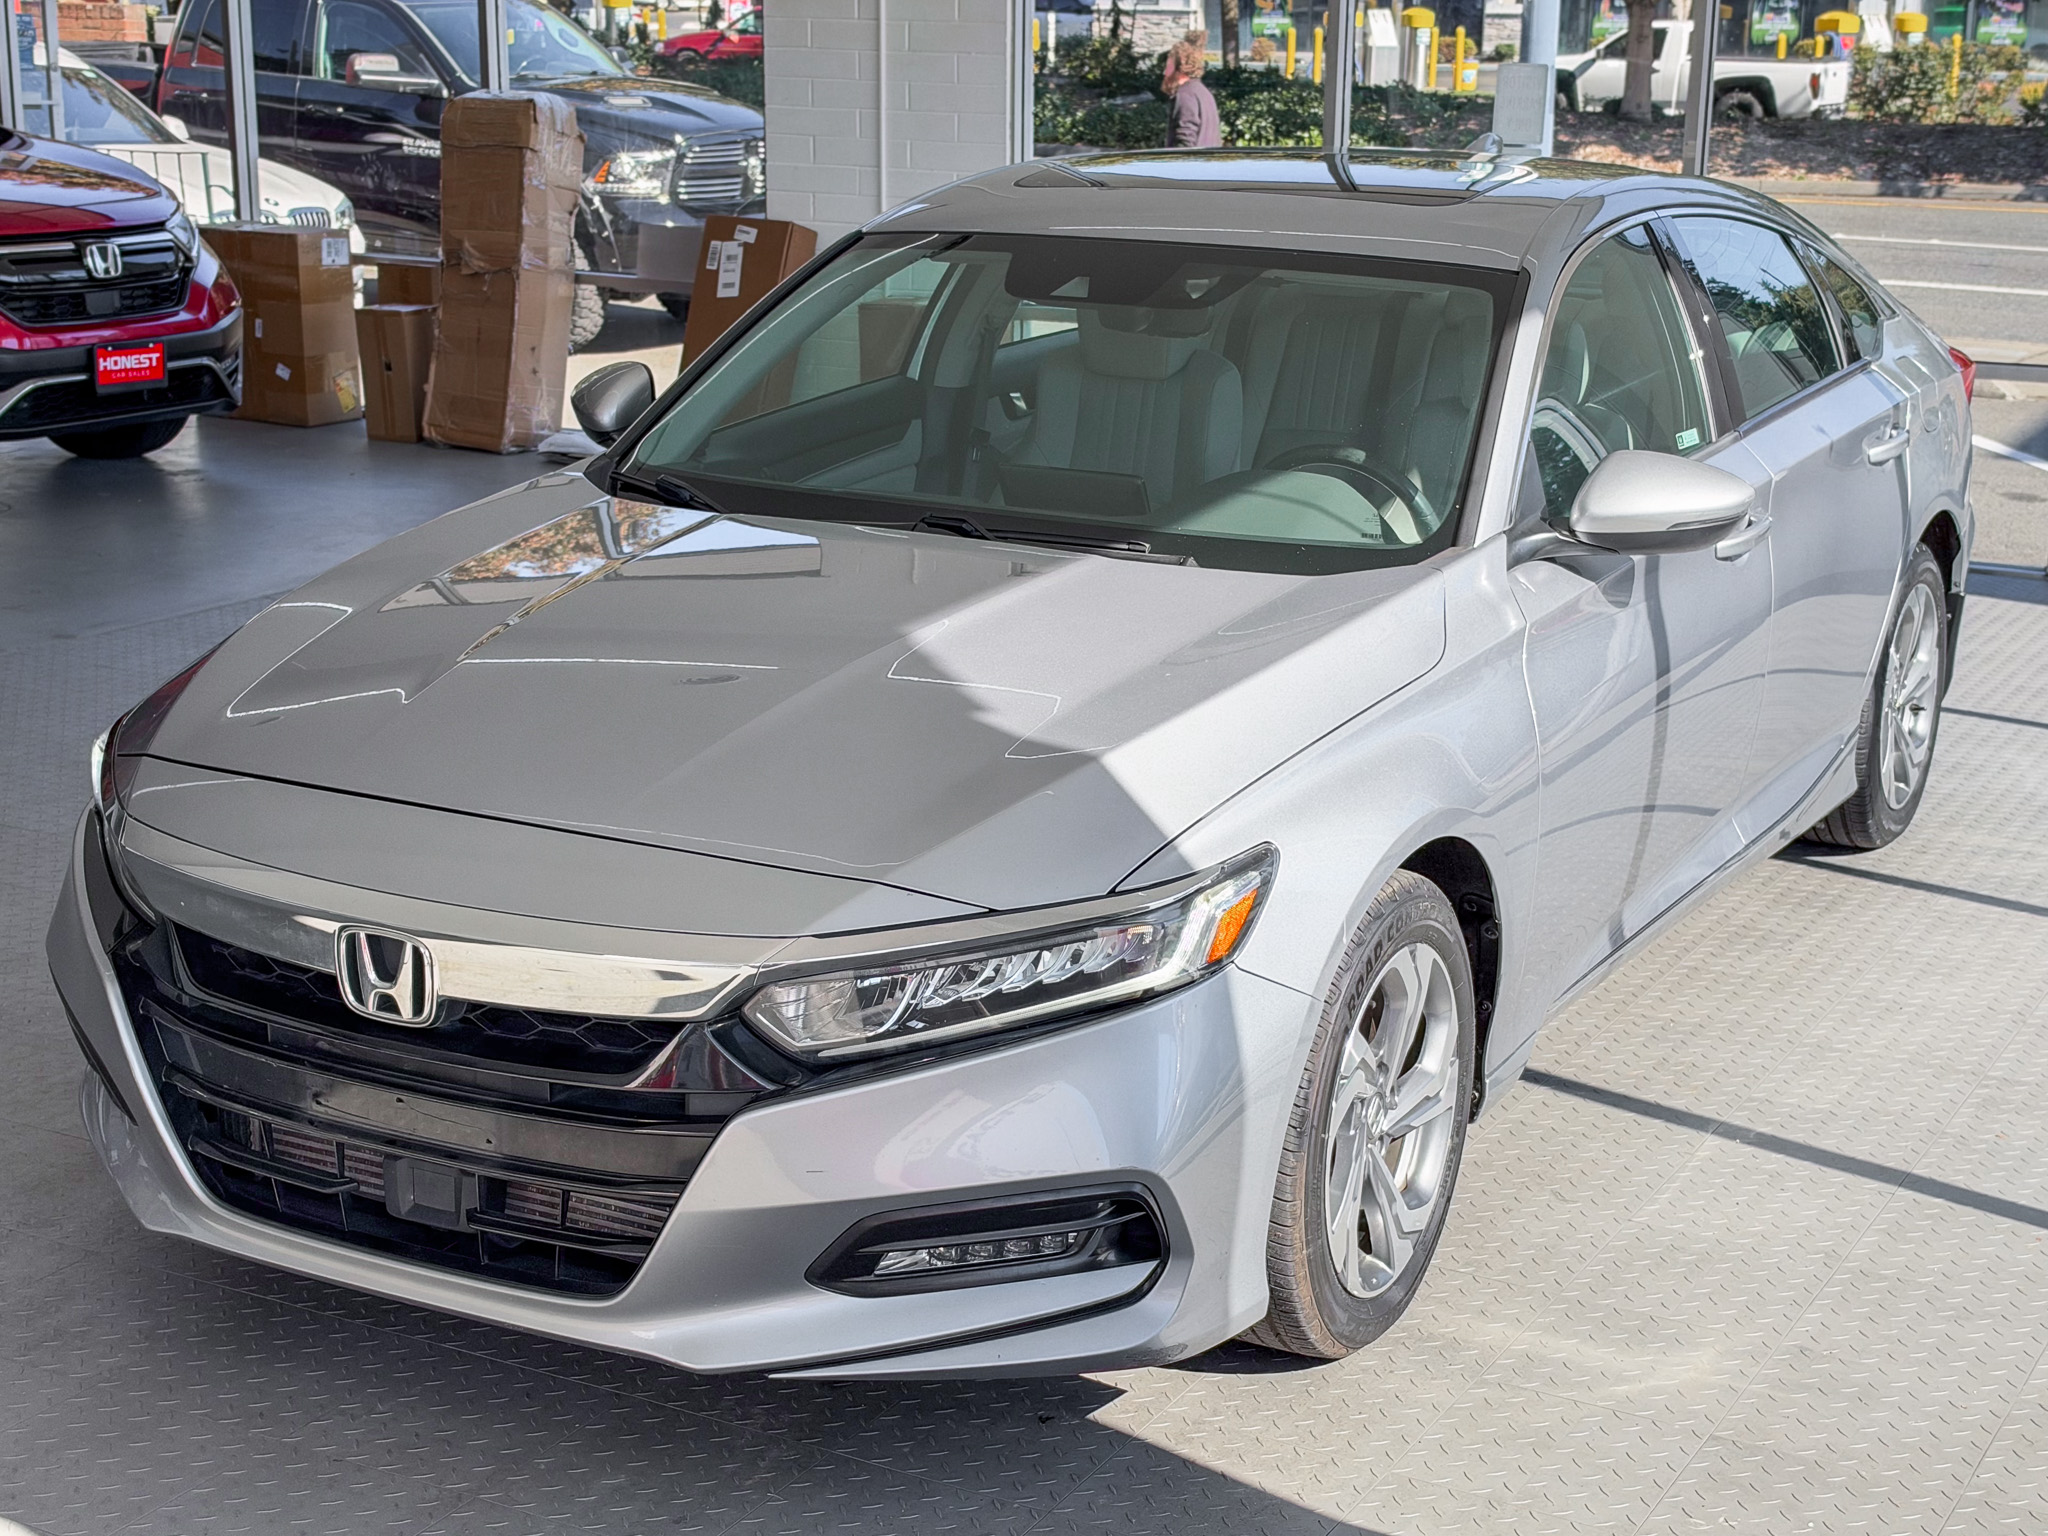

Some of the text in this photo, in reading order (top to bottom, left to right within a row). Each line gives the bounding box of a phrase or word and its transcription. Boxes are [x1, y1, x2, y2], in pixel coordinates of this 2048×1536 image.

[99, 353, 160, 371] HONEST
[128, 369, 150, 378] SALES
[1347, 902, 1443, 1019] ROAD CONTROL
